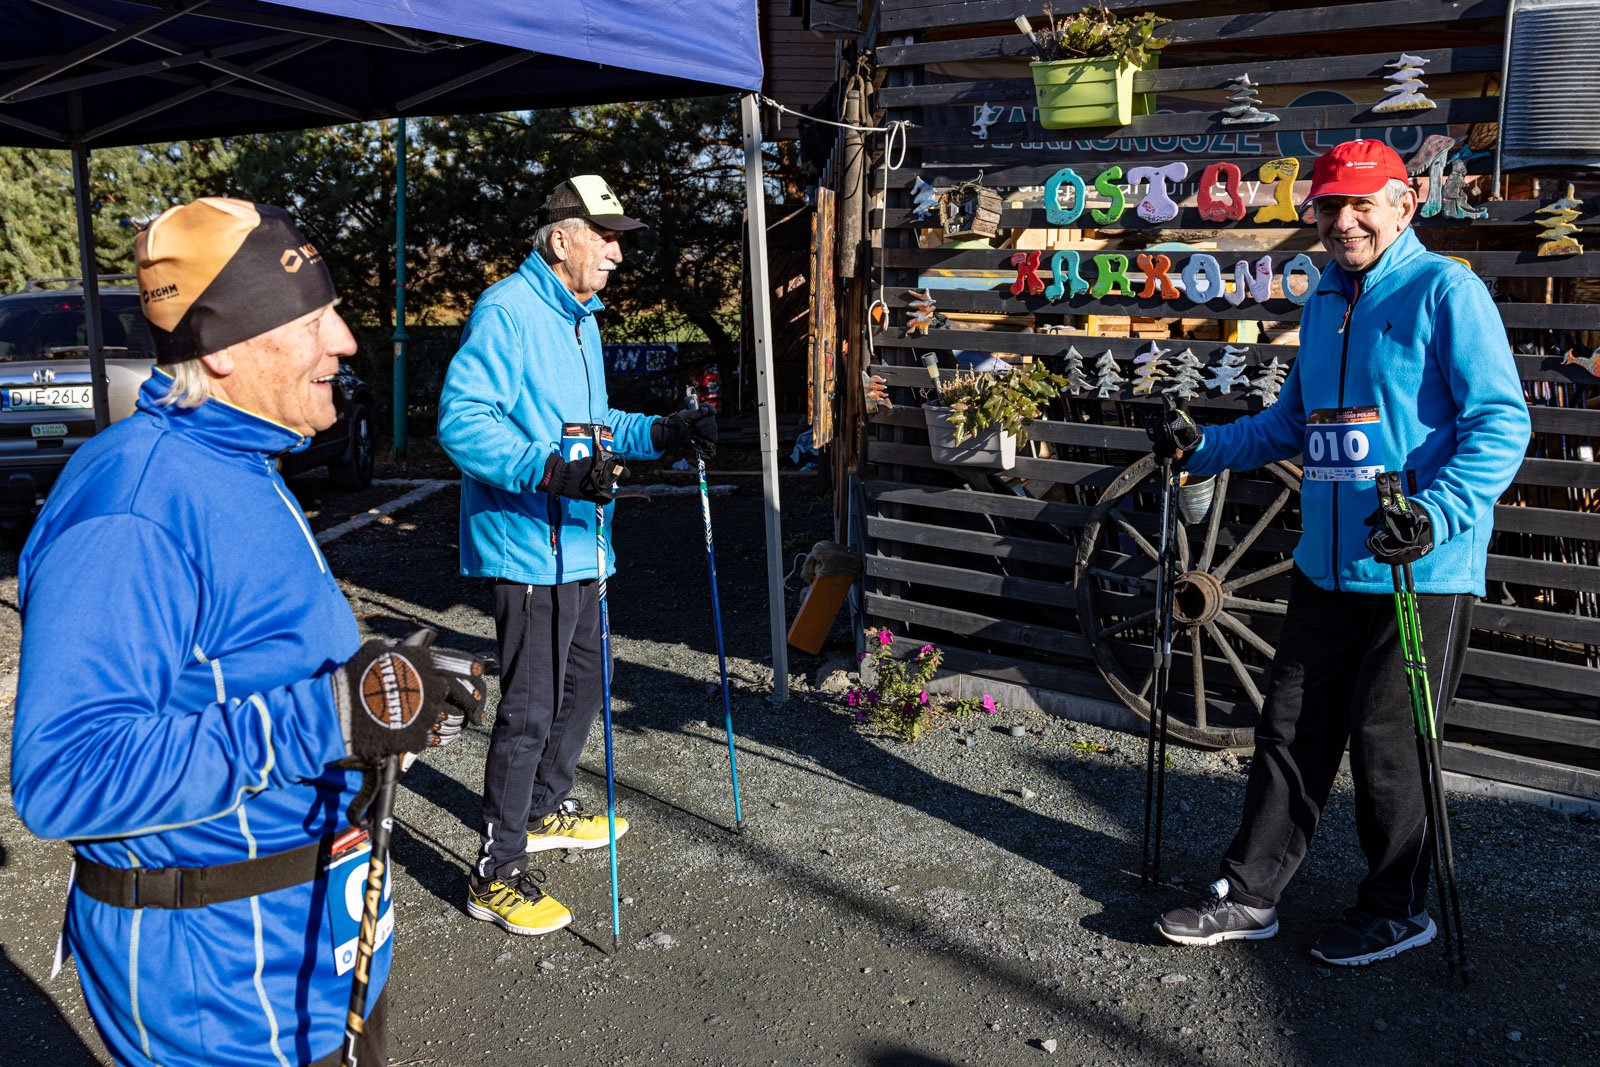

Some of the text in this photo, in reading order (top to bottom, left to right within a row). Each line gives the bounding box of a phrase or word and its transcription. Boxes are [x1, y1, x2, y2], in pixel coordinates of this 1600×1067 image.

[1043, 156, 1317, 226] OSTOJ
[150, 283, 178, 299] KGHM
[11, 390, 46, 407] DJE
[52, 388, 90, 405] 26L6
[1309, 429, 1370, 462] 010
[353, 855, 385, 986] FIZAN
